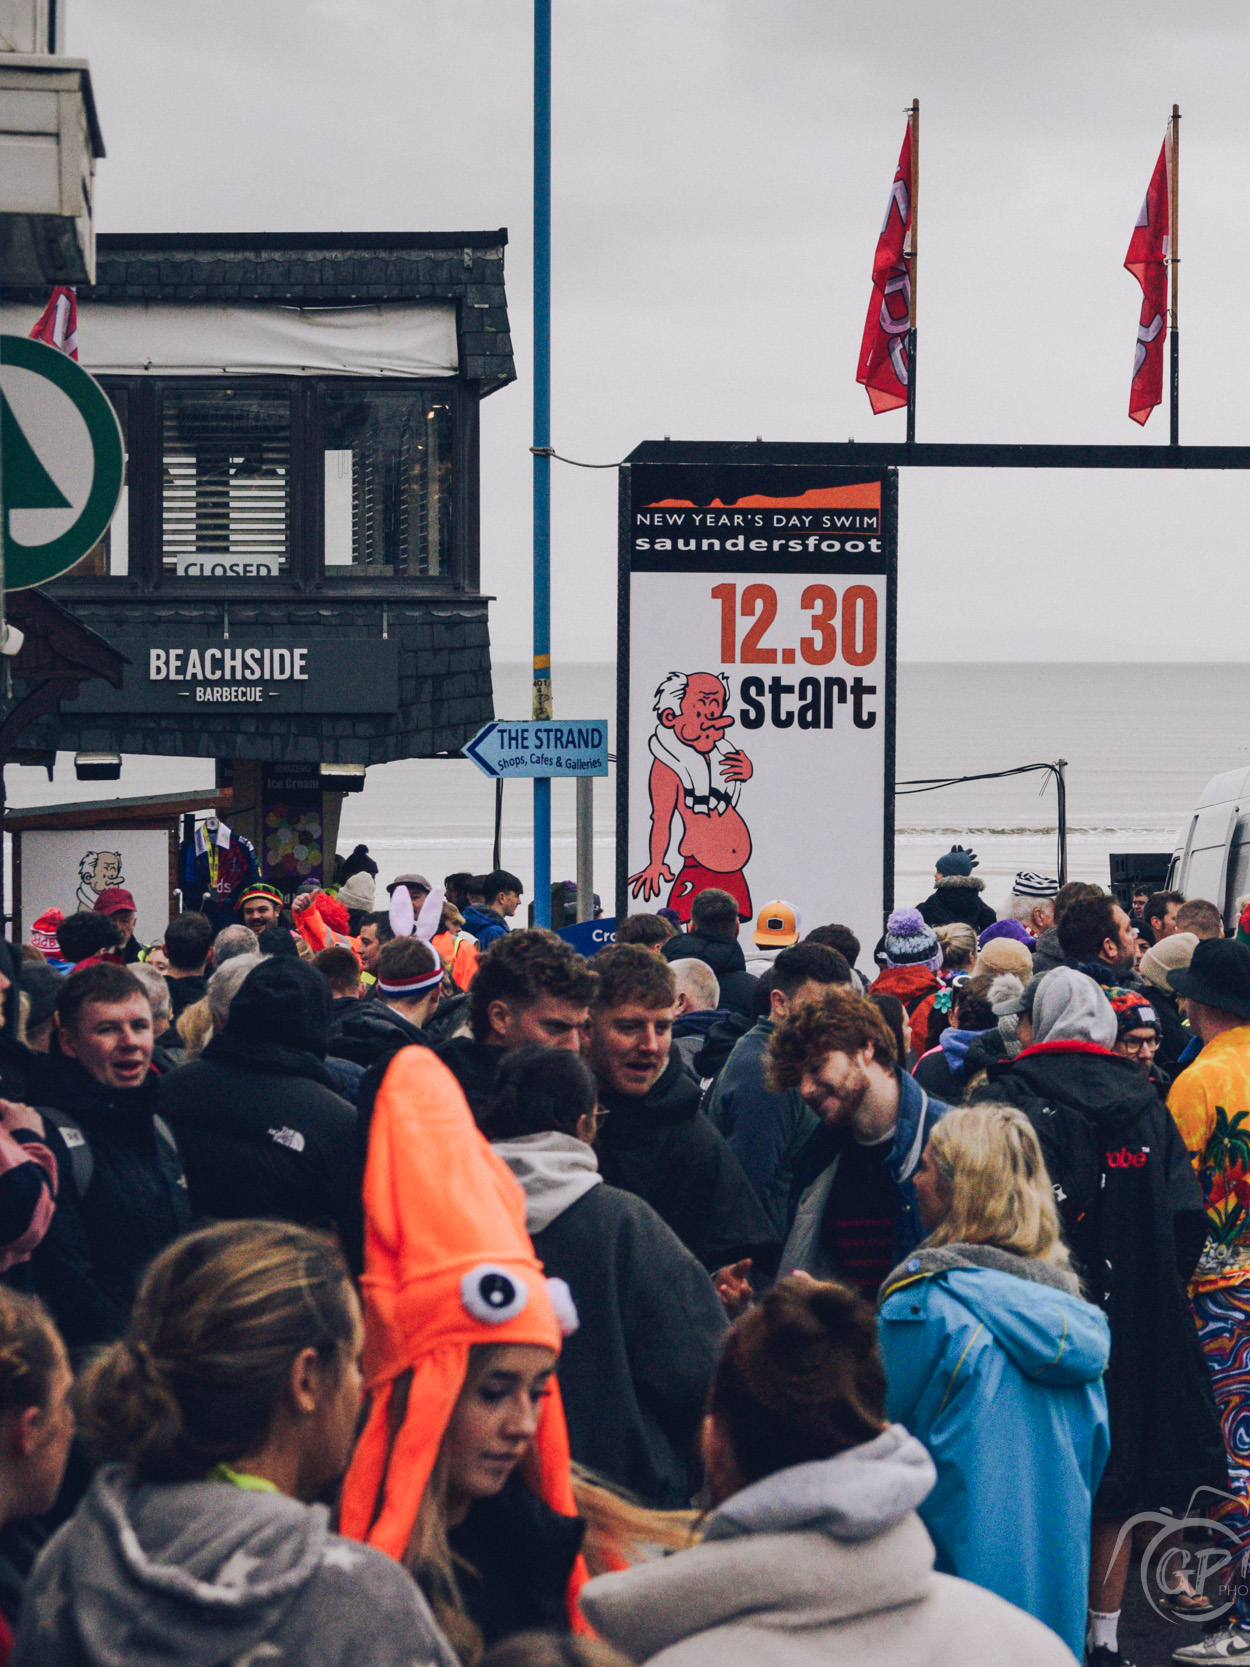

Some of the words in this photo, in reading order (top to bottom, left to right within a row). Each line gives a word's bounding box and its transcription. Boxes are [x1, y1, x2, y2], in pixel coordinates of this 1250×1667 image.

[637, 513, 685, 526] NEW
[692, 514, 763, 527] YEAR'S
[773, 515, 813, 527] DAY
[822, 516, 877, 528] SWIM
[635, 535, 882, 552] saundersfoot
[711, 582, 878, 666] 12.30
[150, 648, 308, 680] BEACHSIDE
[196, 687, 263, 702] BARBECUE
[739, 675, 877, 730] start
[497, 728, 529, 750] THE
[534, 728, 602, 750] STRAND
[498, 755, 528, 771] Shops,
[530, 753, 553, 766] Cafes
[555, 756, 562, 768] &
[565, 757, 602, 770] Galleries
[285, 778, 319, 789] Cream
